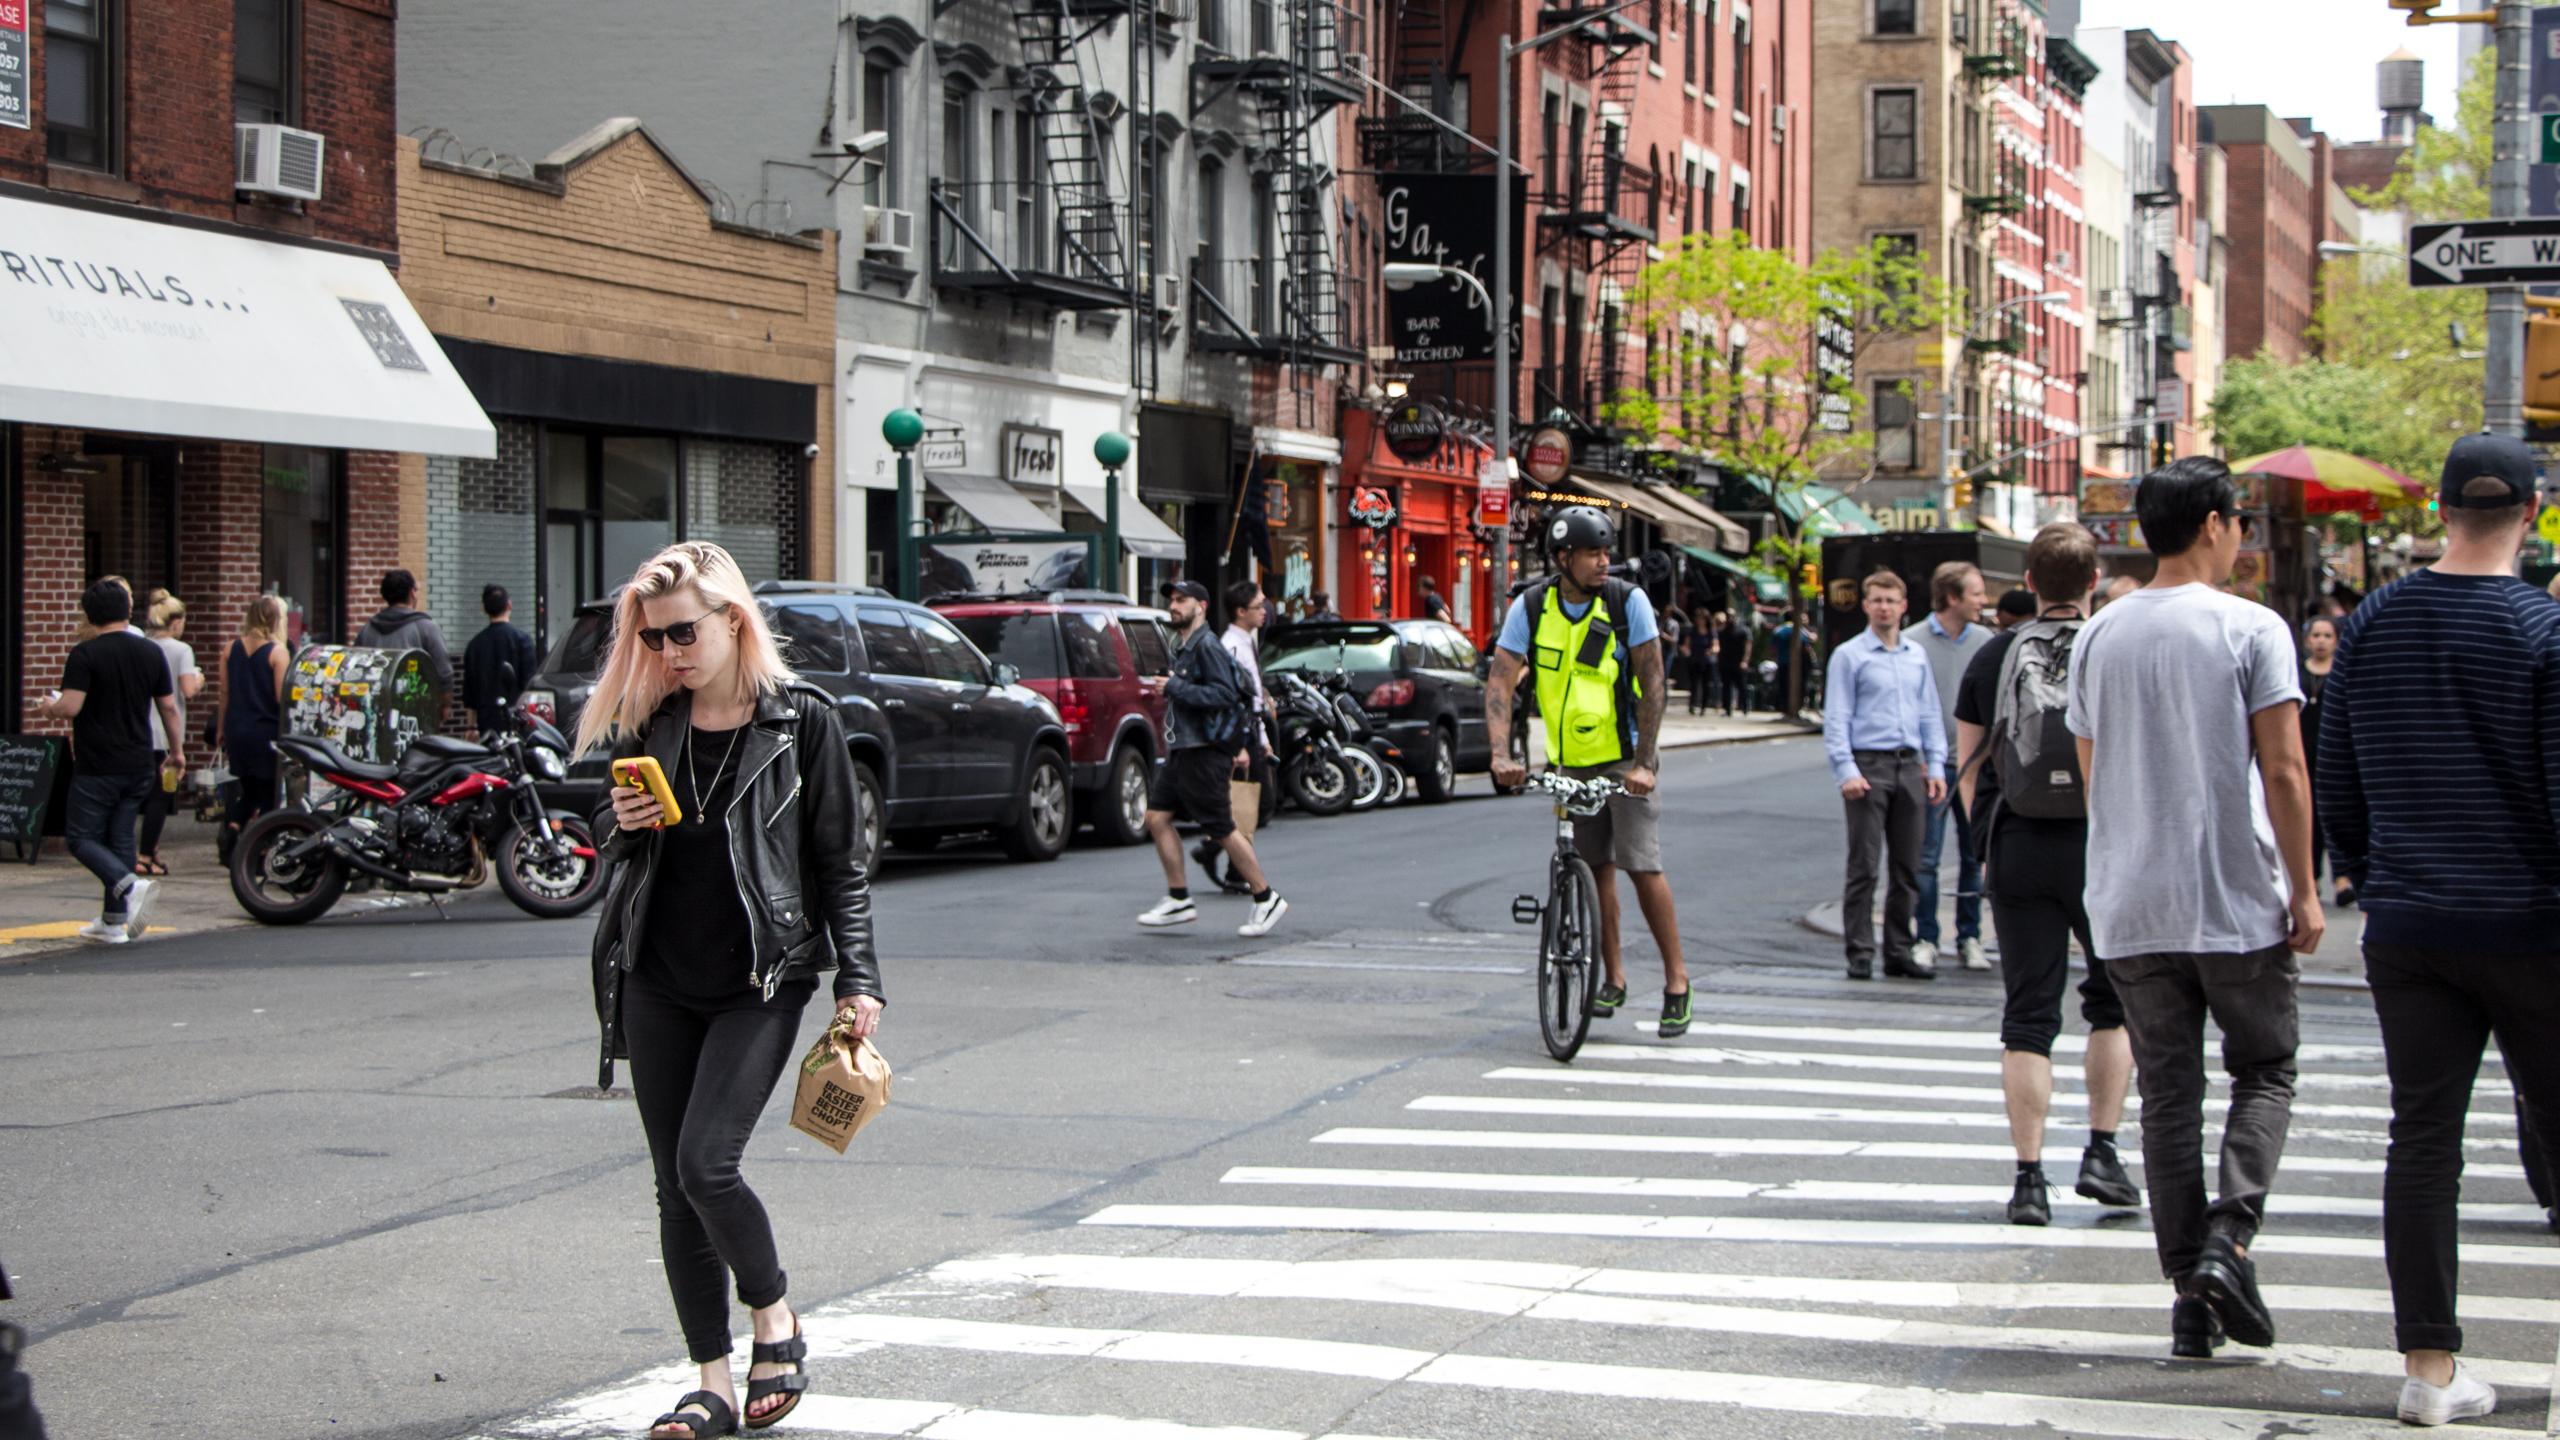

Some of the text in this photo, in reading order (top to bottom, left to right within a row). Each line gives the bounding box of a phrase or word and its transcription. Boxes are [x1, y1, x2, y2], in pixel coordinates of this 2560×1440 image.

[2436, 240, 2496, 266] ONE
[47, 303, 211, 342] enjoy the moment
[1406, 317, 1441, 333] BAR
[1417, 333, 1431, 346] &
[1398, 345, 1464, 362] KITCHEN
[1388, 422, 1440, 435] GUINNESS
[925, 446, 962, 463] fresh
[1013, 432, 1056, 478] fresh
[975, 553, 1007, 562] FATE
[978, 560, 1030, 570] FURIOUS
[821, 1088, 860, 1113] TASTES
[824, 1080, 865, 1105] BETTER
[811, 1106, 853, 1131] CHOP'T
[816, 1097, 856, 1121] BETTER
